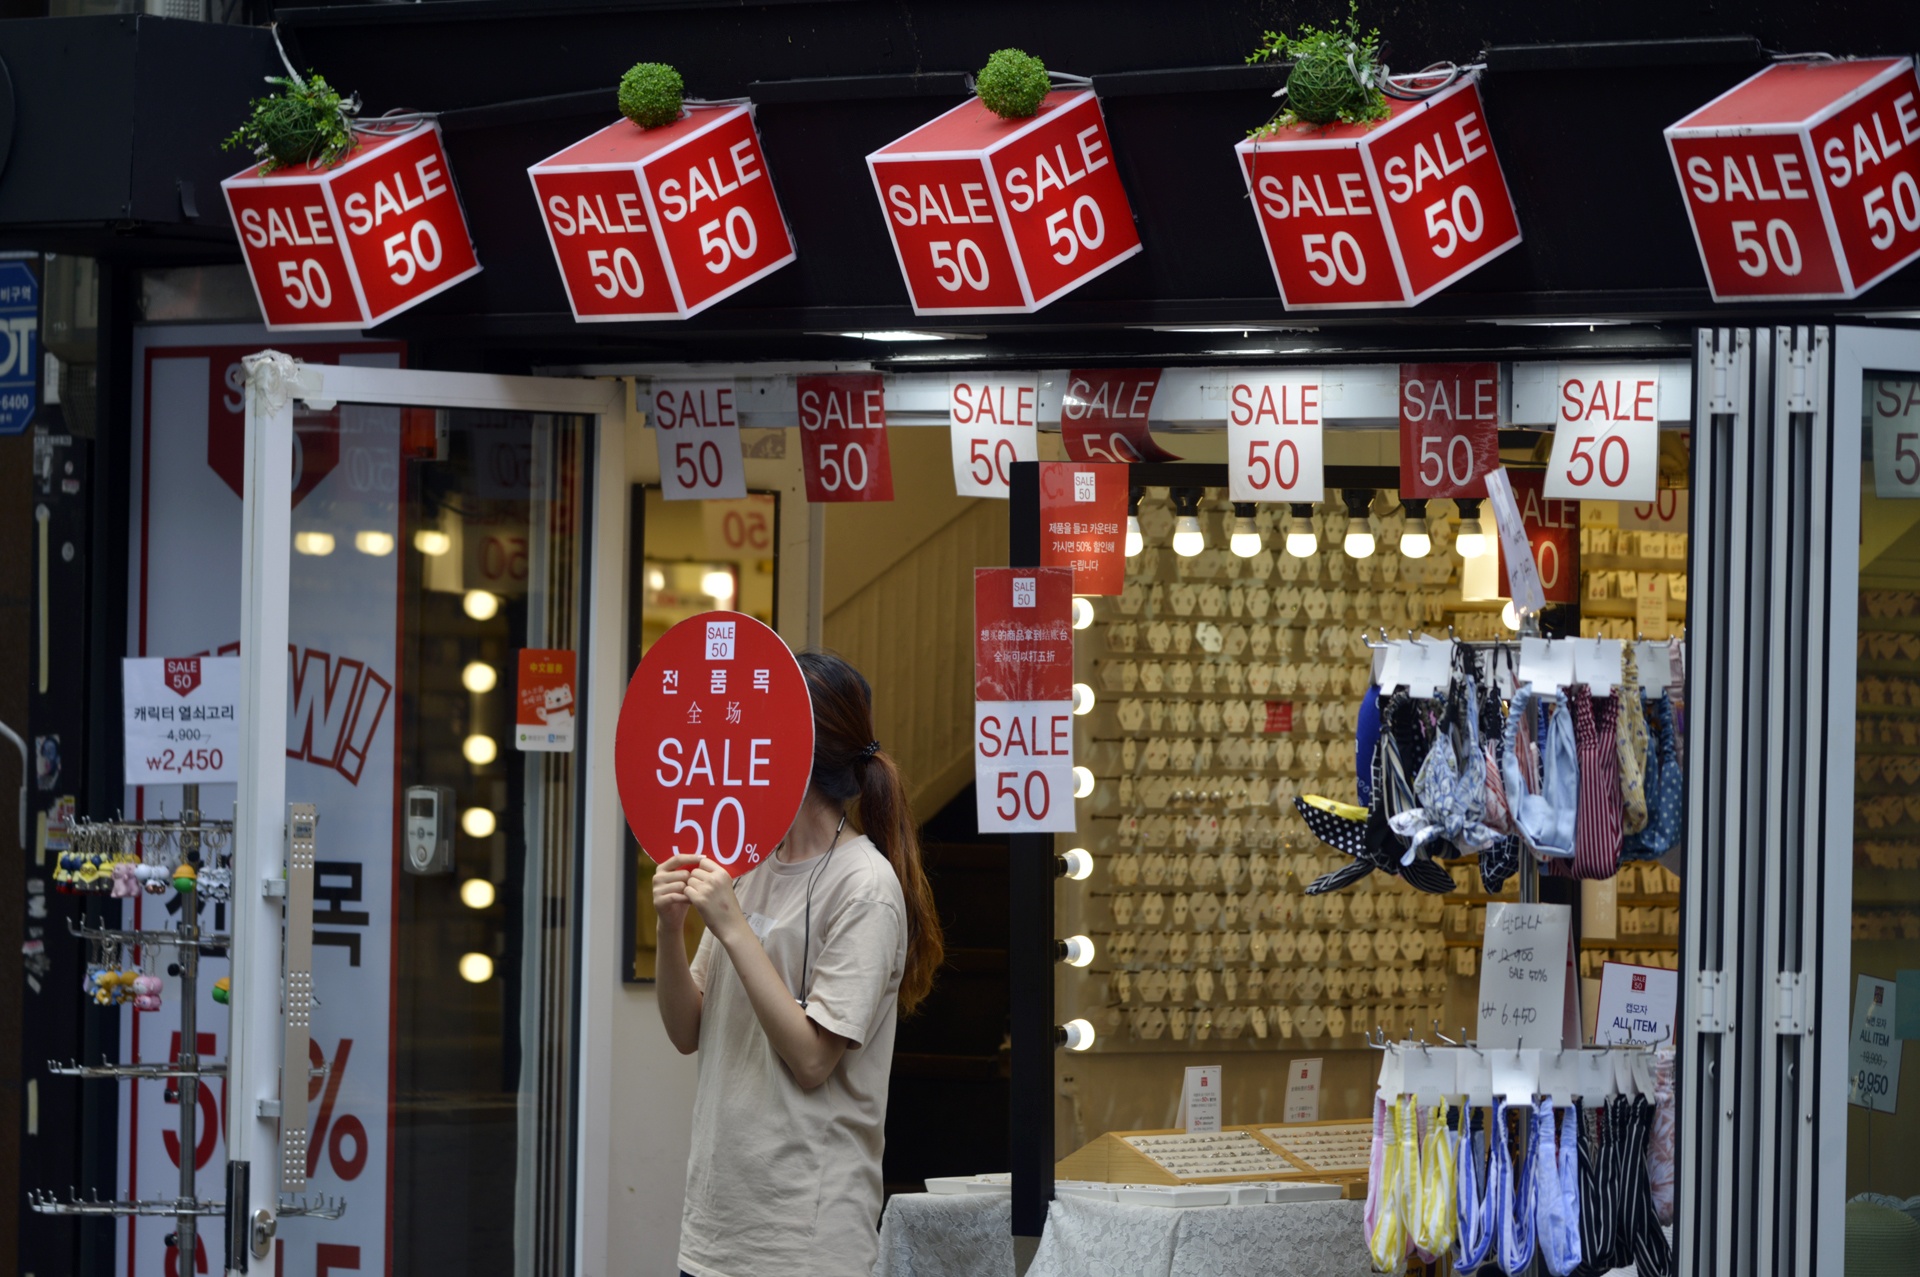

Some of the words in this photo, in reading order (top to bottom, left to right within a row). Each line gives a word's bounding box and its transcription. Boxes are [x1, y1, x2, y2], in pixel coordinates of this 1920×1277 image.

[1384, 112, 1487, 204] SALE
[1823, 91, 1920, 188] SALE
[658, 138, 761, 222] SALE
[1005, 124, 1108, 213] SALE
[1687, 153, 1809, 204] SALE
[344, 154, 447, 235] SALE
[548, 193, 647, 236] SALE
[889, 182, 993, 227] SALE
[1258, 173, 1372, 220] SALE
[1863, 171, 1920, 251] 50
[241, 205, 333, 249] SALE
[698, 205, 758, 275] 50
[1045, 195, 1105, 266] 50
[1425, 184, 1485, 259] 50
[383, 219, 443, 286] 50
[929, 238, 989, 291] 50
[1301, 231, 1367, 286] 50
[1731, 218, 1802, 277] 50
[278, 258, 332, 309] 50
[587, 247, 645, 298] 50
[656, 388, 736, 431] SALE
[801, 389, 883, 431] SALE
[952, 383, 1034, 426] SALE
[1065, 379, 1155, 420] SALE
[1231, 384, 1319, 426] SALE
[1403, 379, 1494, 422] SALE
[1561, 378, 1654, 422] SALE
[676, 440, 724, 489] 50
[819, 442, 869, 492] 50
[970, 438, 1018, 488] 50
[1075, 476, 1094, 486] SALE
[1247, 439, 1299, 490] 50
[1419, 434, 1474, 487] 50
[1566, 435, 1630, 488] 50
[1079, 489, 1090, 500] 50
[1513, 487, 1576, 529] ALE
[1049, 522, 1071, 534] 제품을
[1073, 523, 1088, 534] 들고
[1090, 523, 1119, 535] 카운터로
[1052, 541, 1074, 553] 가시면
[1076, 541, 1092, 552] 50%
[1093, 541, 1115, 553] 할인해
[1014, 582, 1034, 592] SALE
[1070, 559, 1099, 571] 드립니다
[1529, 541, 1559, 589] 0
[1018, 594, 1030, 605] 50
[707, 627, 734, 640] SALE
[711, 642, 728, 657] 50
[168, 661, 197, 673] SALE
[173, 674, 192, 689] 50
[134, 706, 174, 721] 캐릭터
[179, 705, 234, 721] 열쇠고리
[167, 729, 201, 742] 4,900
[979, 715, 1069, 758] SALE
[146, 749, 223, 774] ₩2,450
[656, 737, 771, 788] SALE
[996, 770, 1050, 821] 50
[1509, 966, 1524, 980] SALE
[1632, 975, 1646, 983] SALE
[1634, 982, 1643, 990] 50
[1613, 1016, 1629, 1029] ALL
[1633, 1019, 1657, 1033] ITEM
[1860, 1029, 1871, 1043] ALL
[1872, 1033, 1889, 1047] ITEM
